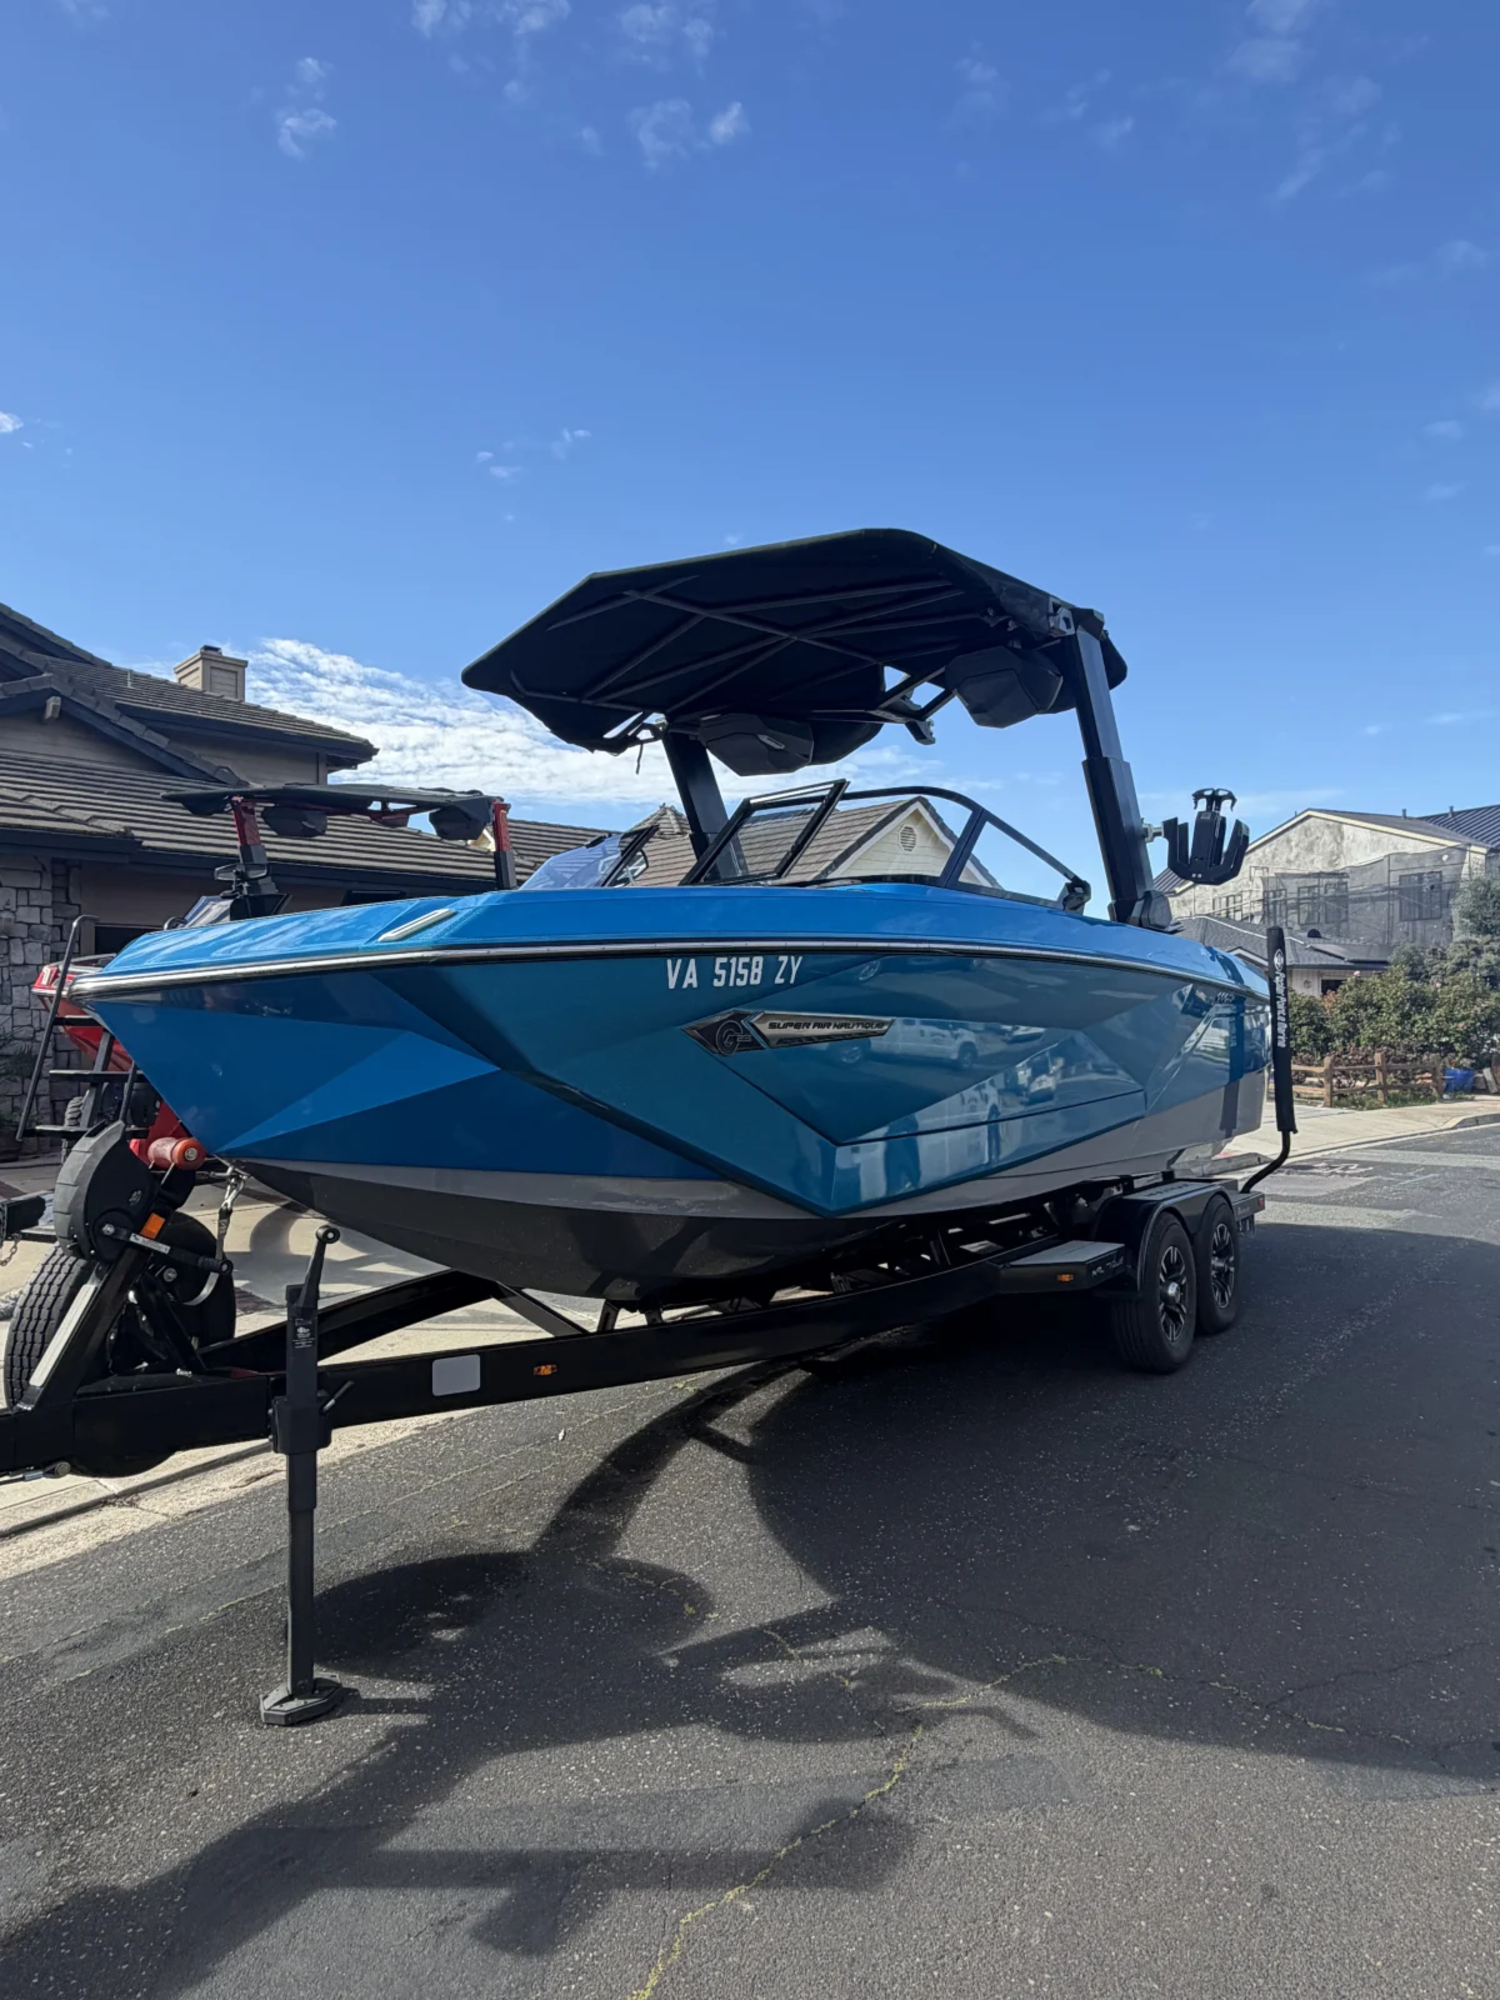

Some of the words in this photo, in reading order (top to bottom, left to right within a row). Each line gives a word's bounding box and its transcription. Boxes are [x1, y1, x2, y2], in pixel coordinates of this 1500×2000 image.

[666, 958, 698, 989] VA
[712, 956, 764, 987] 5158
[774, 955, 803, 985] ZY
[767, 1021, 811, 1030] SUPER
[811, 1021, 833, 1030] AIR
[832, 1021, 886, 1030] NAUTIQUE
